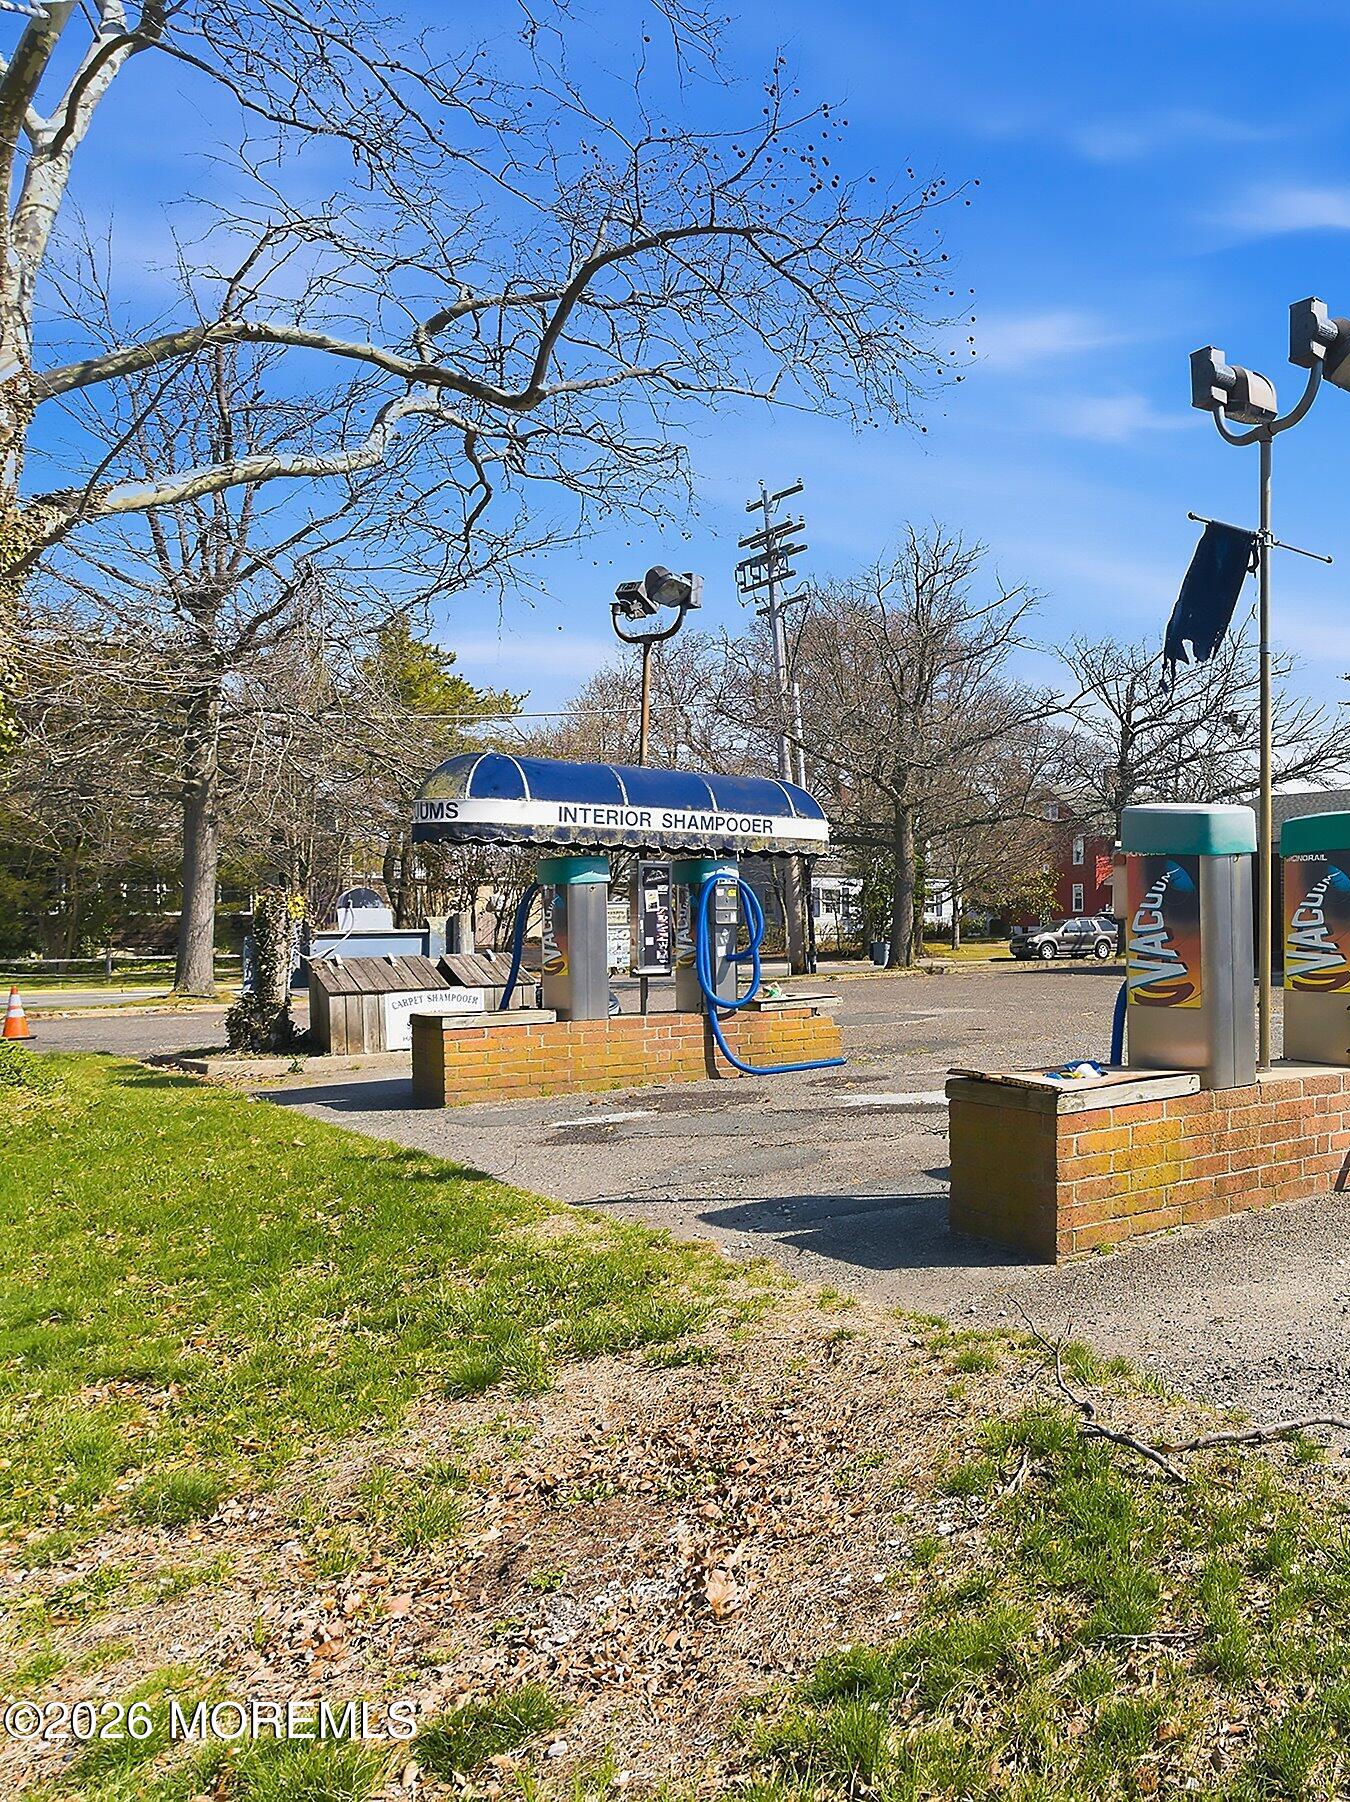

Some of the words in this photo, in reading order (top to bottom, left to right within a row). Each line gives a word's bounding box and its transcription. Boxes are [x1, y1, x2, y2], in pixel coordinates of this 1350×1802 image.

[557, 805, 652, 828] INTERIOR
[661, 812, 774, 834] SHAMPOOER
[1128, 867, 1187, 989] VACUUM
[1286, 871, 1347, 977] VACUUM
[391, 995, 423, 1010] CARPET
[427, 993, 479, 1005] SHAMPOOER
